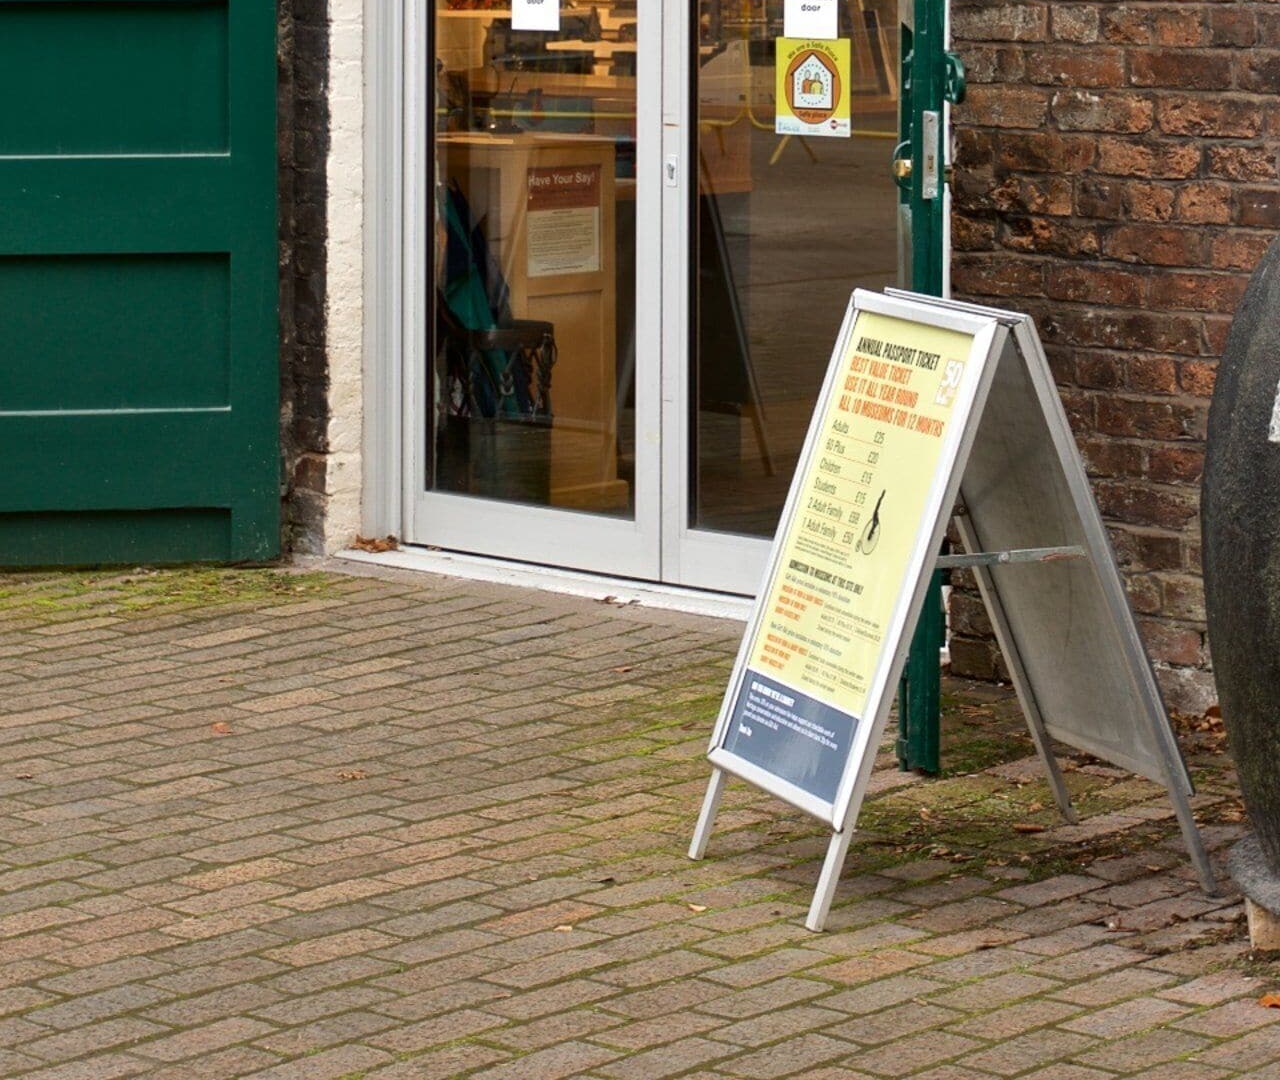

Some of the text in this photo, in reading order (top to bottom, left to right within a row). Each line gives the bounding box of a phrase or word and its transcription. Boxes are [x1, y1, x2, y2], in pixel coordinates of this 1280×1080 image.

[800, 3, 821, 12] door
[528, 171, 595, 186] Have Your Say!
[856, 336, 941, 371] ANNUAL PASSPORT TICKET
[850, 355, 913, 385] BEST VALUE TICKET
[844, 375, 860, 393] USE
[859, 378, 868, 394] IT
[865, 381, 879, 398] ALL
[878, 383, 897, 404] YEAR
[895, 388, 919, 409] ROUND
[838, 395, 945, 438] ALL 10 MUSEUMS FOR 12 MONTHS
[832, 419, 886, 445] Adults £25
[832, 440, 846, 455] Plus
[819, 457, 841, 474] Children
[813, 476, 837, 496] Students
[812, 497, 828, 514] Adult
[826, 503, 843, 521] Family
[806, 518, 822, 535] Adult
[820, 522, 837, 541] Family
